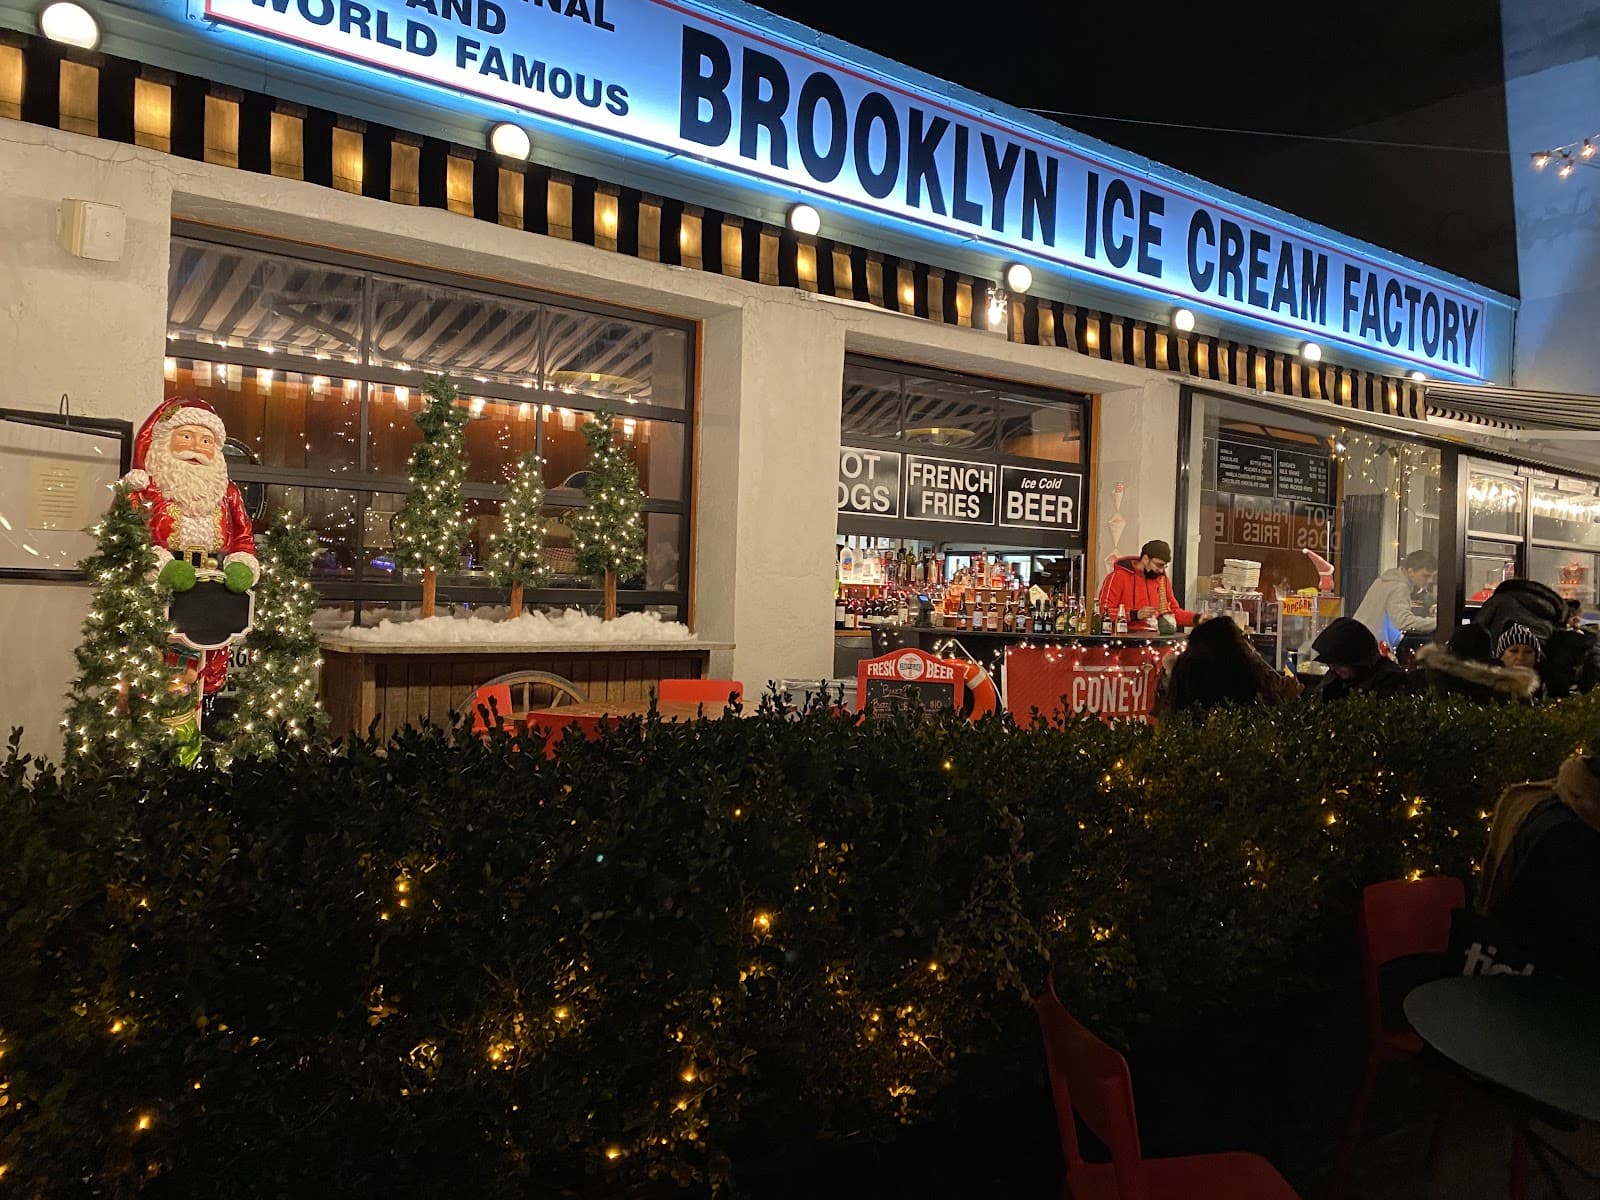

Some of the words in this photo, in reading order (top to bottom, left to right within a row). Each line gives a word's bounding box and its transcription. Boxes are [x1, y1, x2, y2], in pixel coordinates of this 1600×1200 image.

[456, 35, 629, 116] FAMOUS
[680, 24, 1059, 248] BROOKLYN
[1085, 171, 1164, 278] ICE
[1187, 208, 1328, 326] CREAM
[1342, 263, 1479, 368] FACTORY
[840, 452, 880, 480] OT
[909, 462, 994, 494] FRENCH
[838, 481, 890, 512] OGS
[1021, 477, 1037, 489] Ice
[1038, 477, 1062, 490] Cold
[921, 490, 980, 519] FRIES
[1006, 490, 1074, 524] BEER
[867, 658, 897, 677] FRESH
[925, 658, 954, 680] BEER
